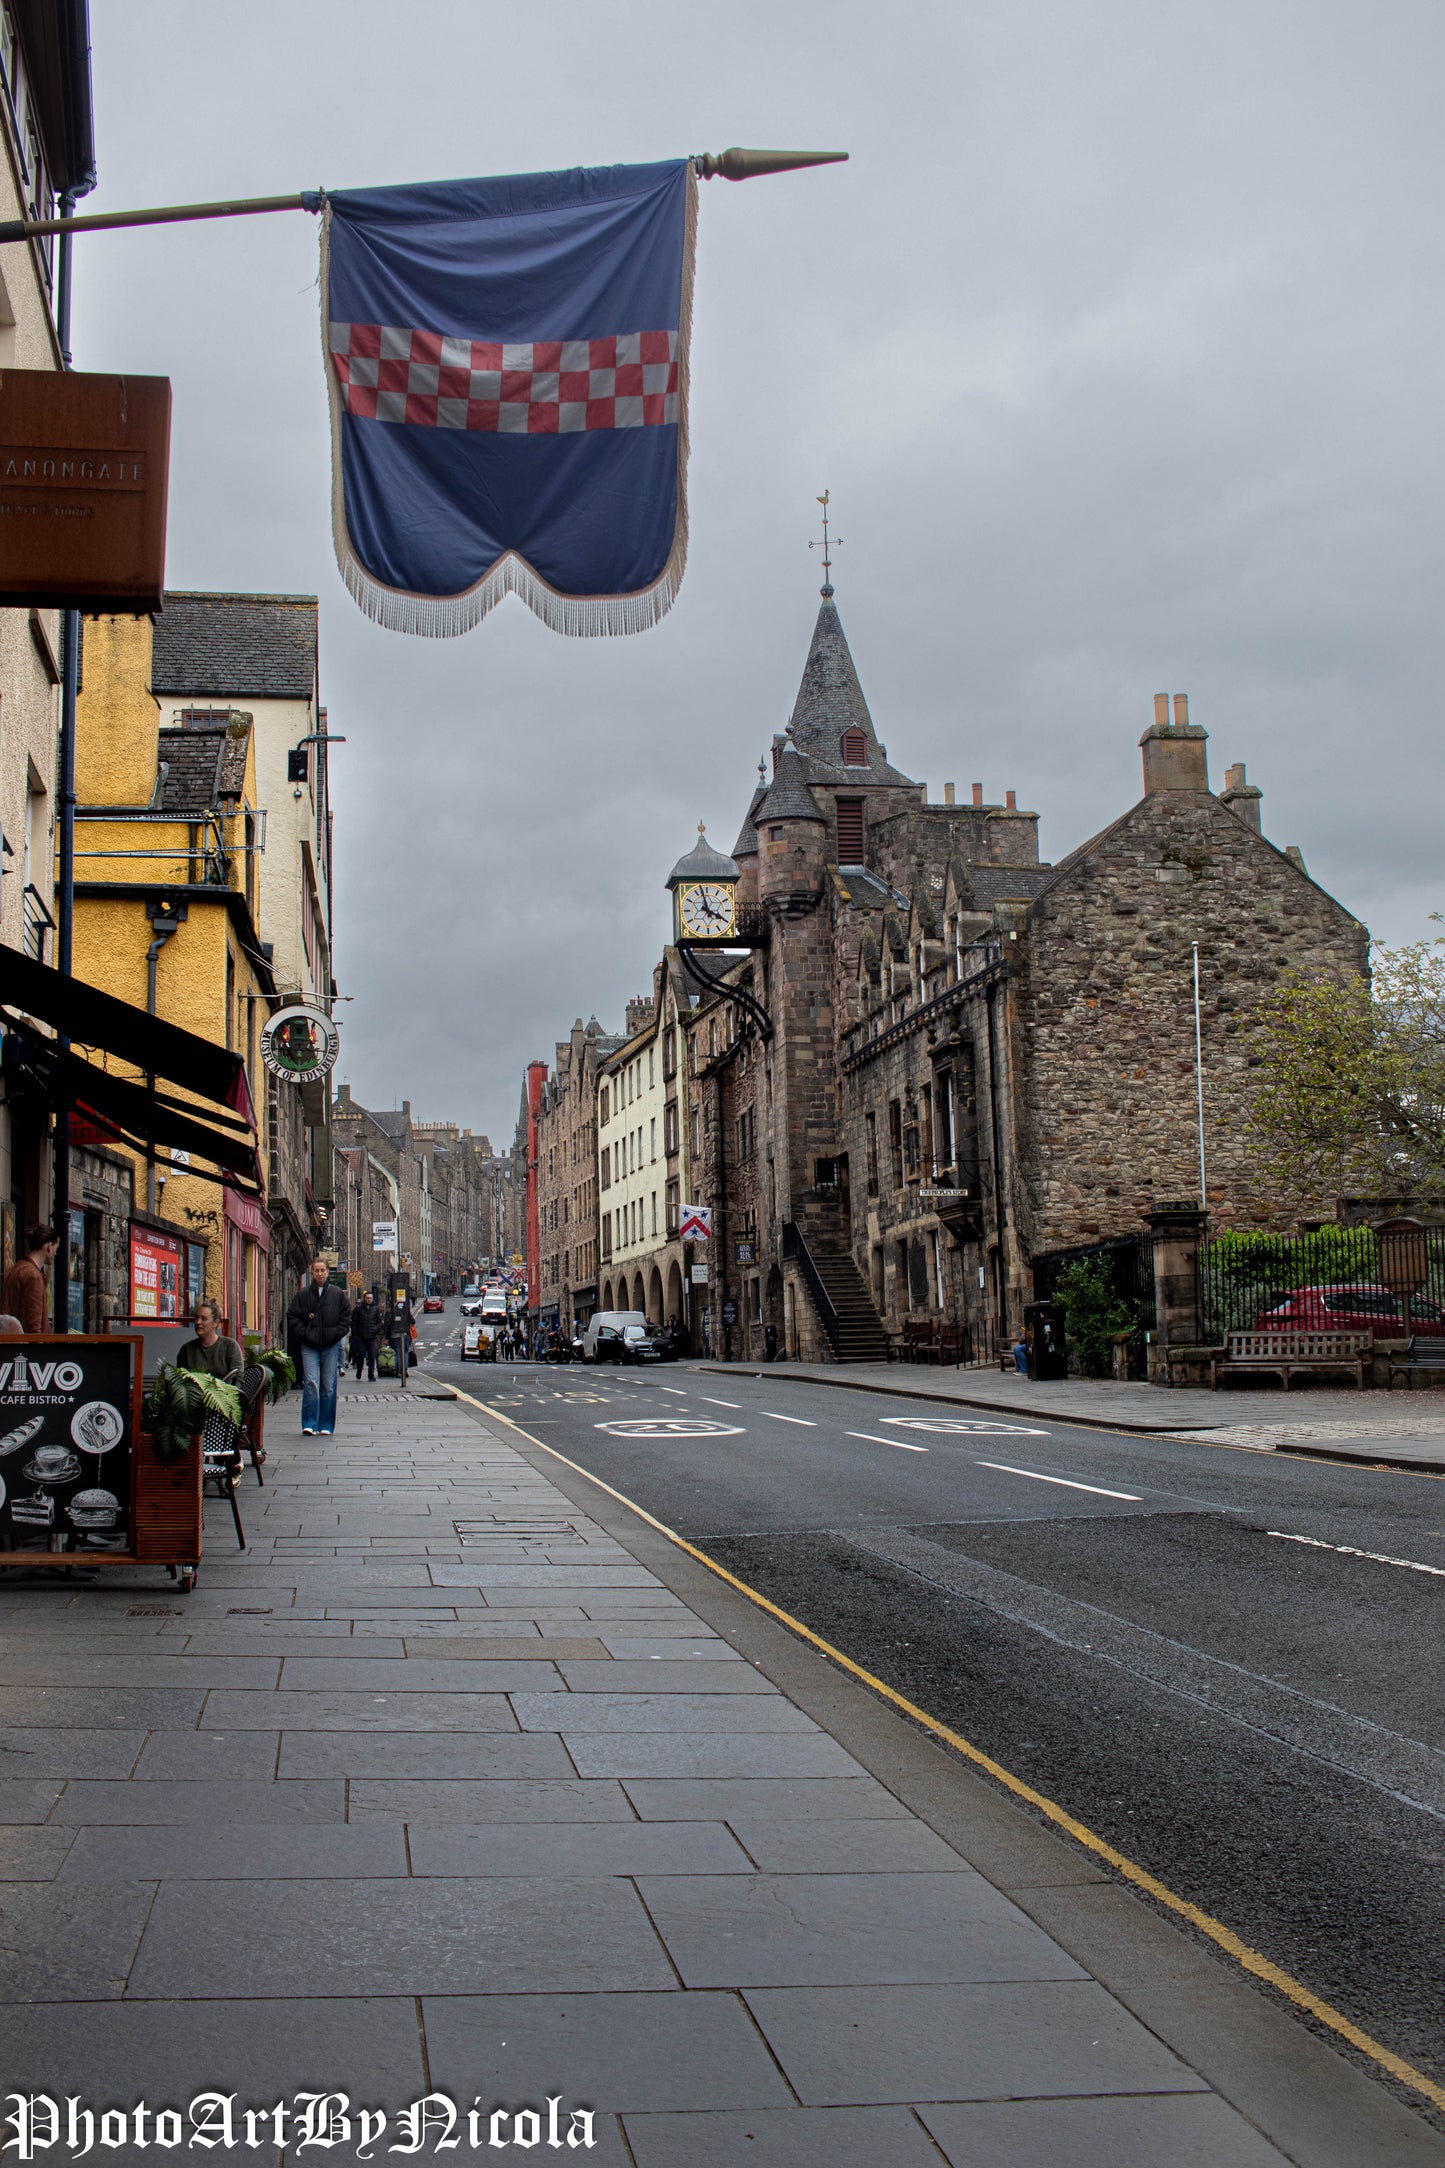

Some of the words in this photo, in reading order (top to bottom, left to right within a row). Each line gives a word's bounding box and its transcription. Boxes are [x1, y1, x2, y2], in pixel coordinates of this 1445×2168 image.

[261, 1029, 283, 1074] MUSEUM
[282, 1069, 296, 1080] OF
[299, 1032, 338, 1082] EDINBURGH
[0, 1395, 26, 1405] CAFE
[28, 1395, 66, 1405] BISTRO
